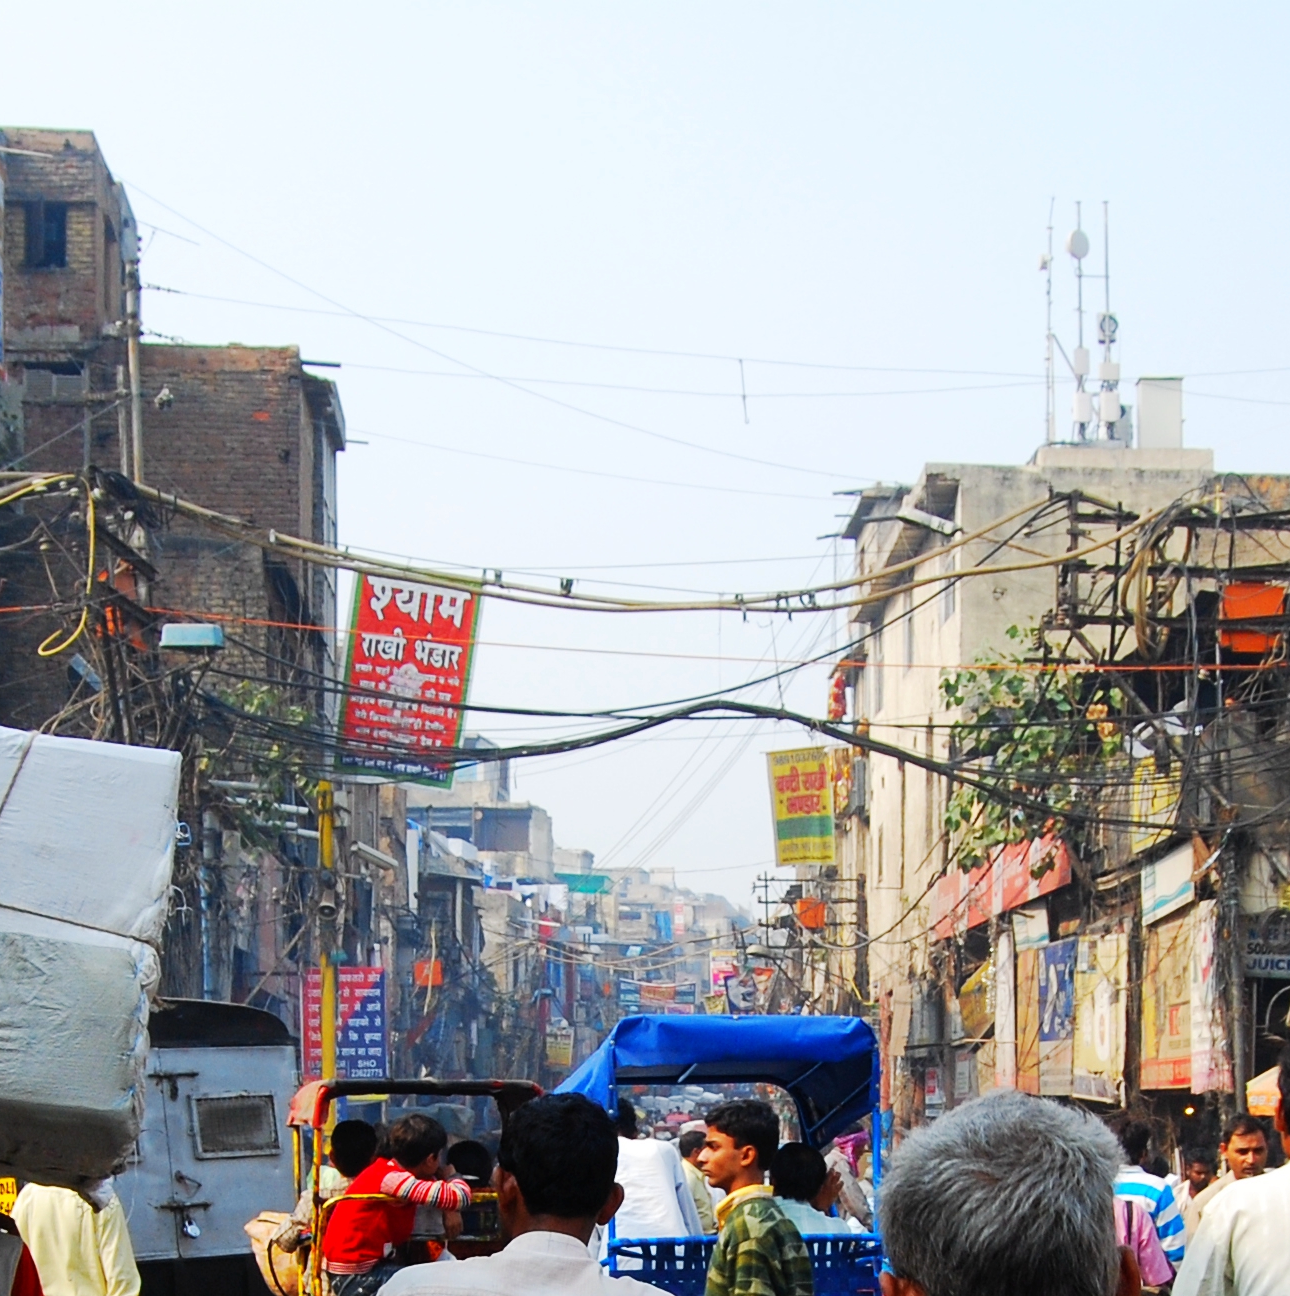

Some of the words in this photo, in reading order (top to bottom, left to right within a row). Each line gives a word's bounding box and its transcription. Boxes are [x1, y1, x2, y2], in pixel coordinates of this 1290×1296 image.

[366, 575, 472, 628] श्याम
[360, 627, 407, 662] राखी
[414, 633, 462, 671] भंडार
[357, 1059, 377, 1068] SHO
